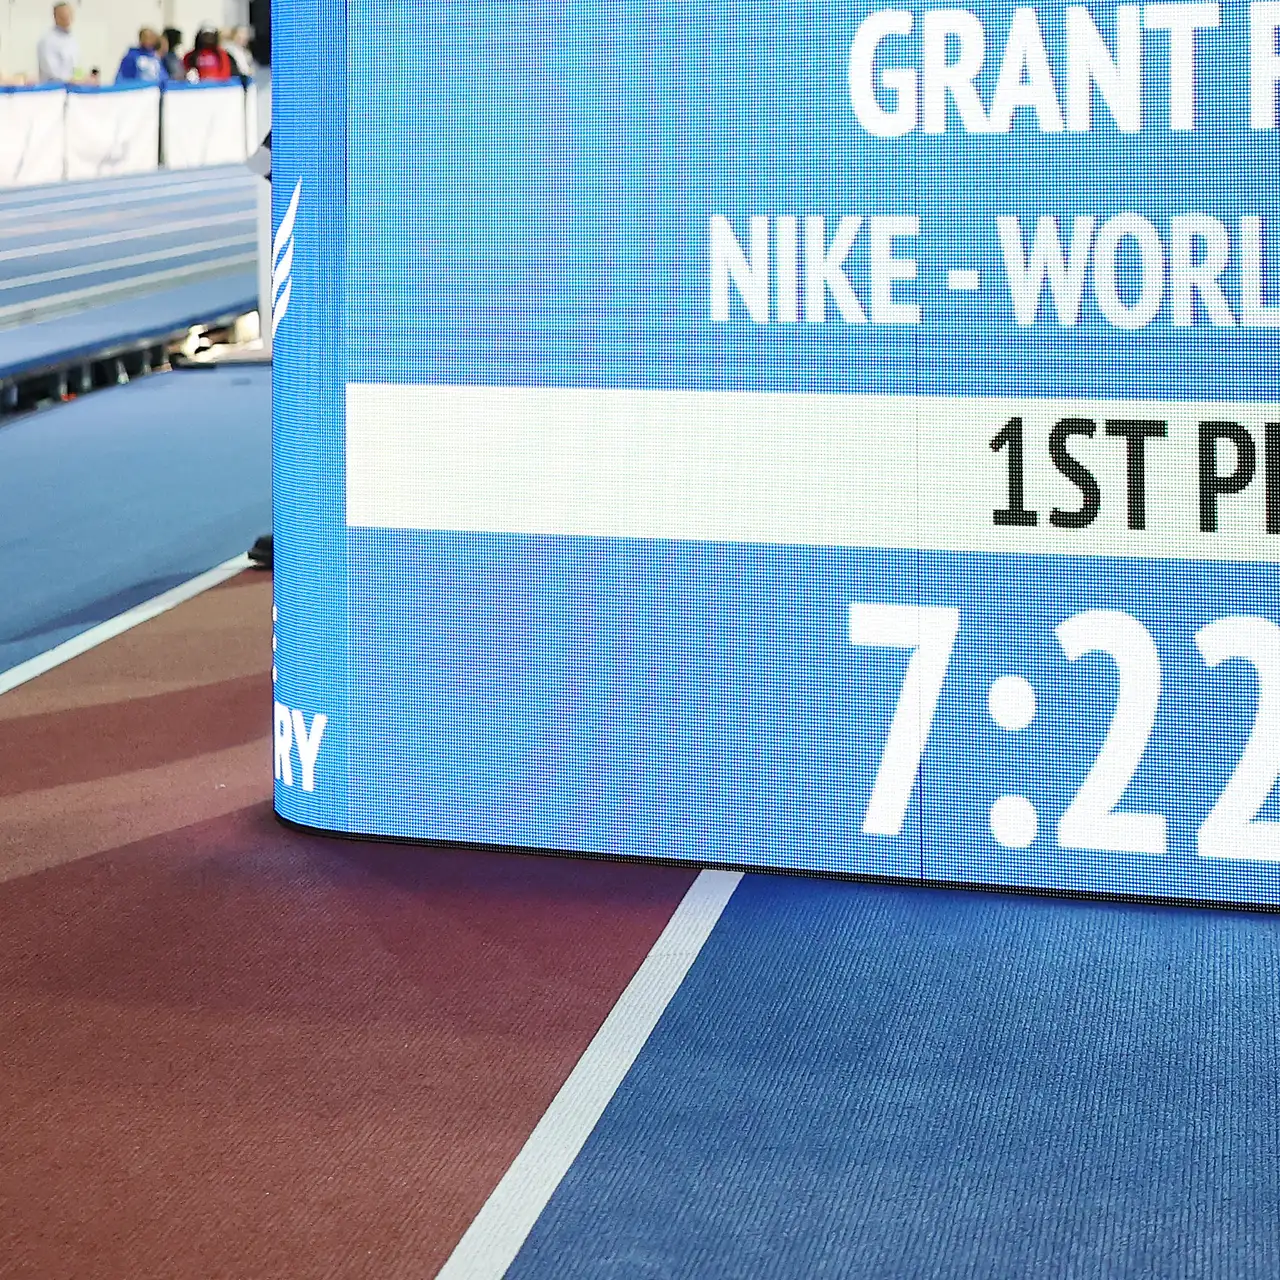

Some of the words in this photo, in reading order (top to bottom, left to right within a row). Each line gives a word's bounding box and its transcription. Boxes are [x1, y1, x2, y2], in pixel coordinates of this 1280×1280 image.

[850, 1, 1220, 138] GRANT
[707, 214, 922, 324] NIKE
[948, 269, 978, 292] -
[988, 417, 1168, 530] 1ST
